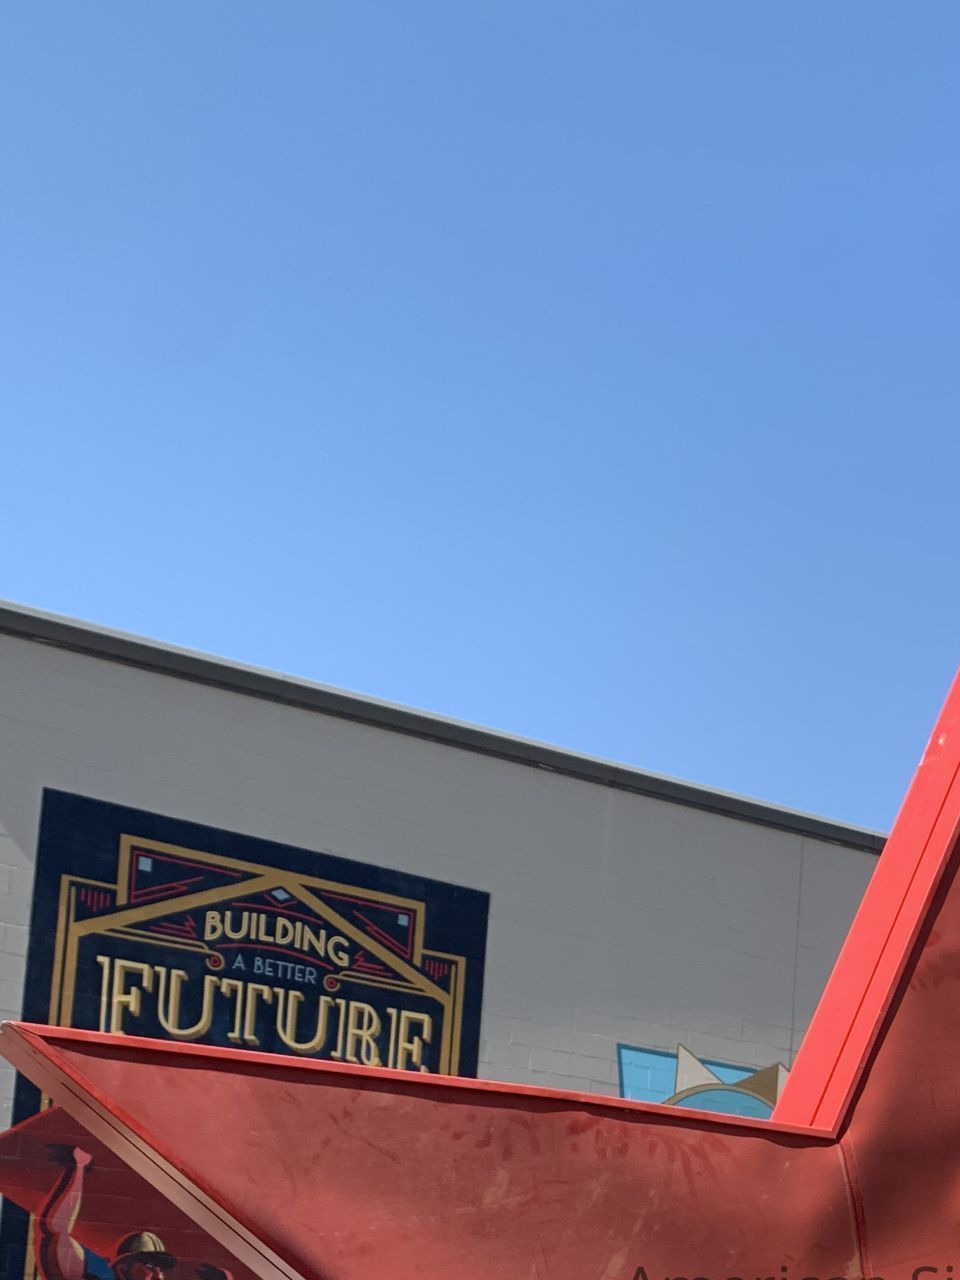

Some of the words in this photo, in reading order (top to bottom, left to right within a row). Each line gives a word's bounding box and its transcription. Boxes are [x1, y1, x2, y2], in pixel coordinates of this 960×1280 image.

[204, 910, 350, 967] BUILDING
[232, 953, 246, 970] A
[253, 956, 317, 985] BETTER
[97, 955, 433, 1073] FUTURE
